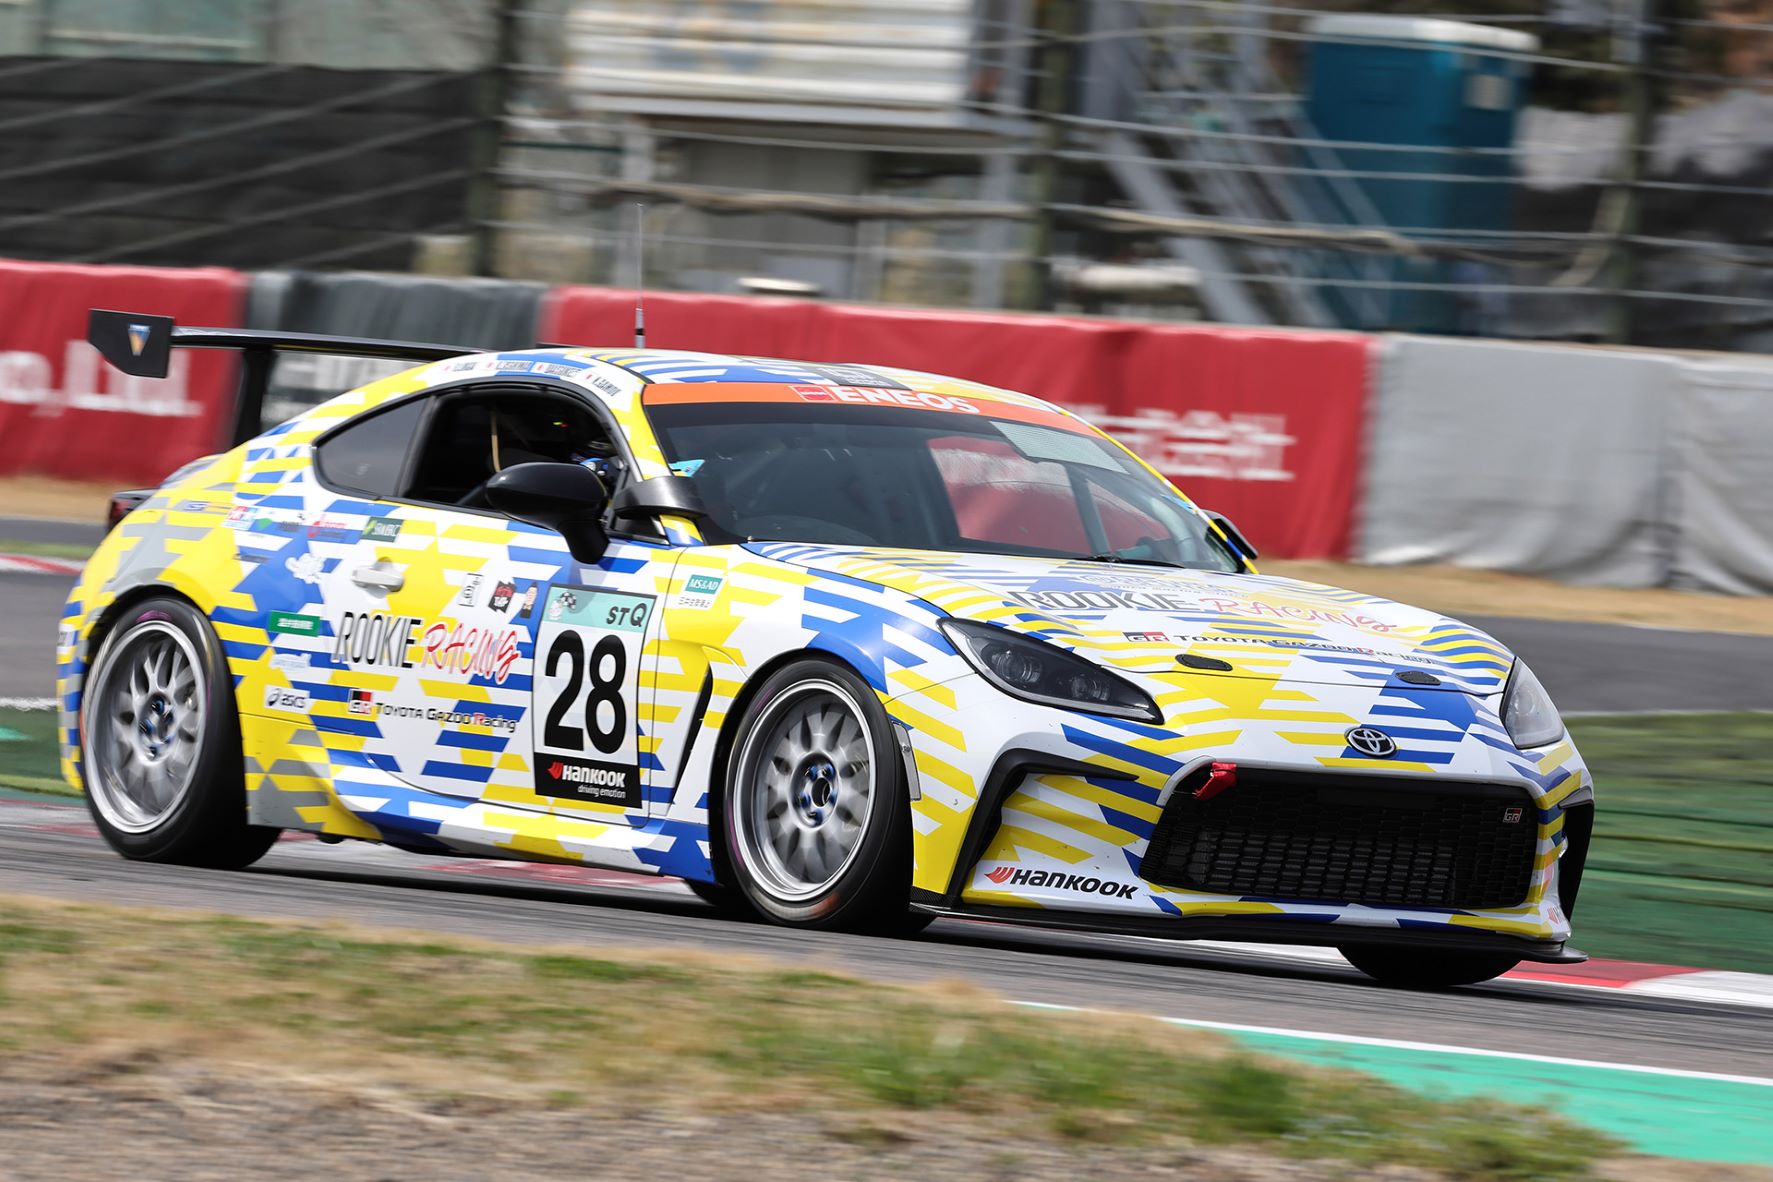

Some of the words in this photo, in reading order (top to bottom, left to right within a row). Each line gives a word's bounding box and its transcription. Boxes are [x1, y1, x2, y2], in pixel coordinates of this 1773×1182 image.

[827, 386, 981, 415] ENEOS
[688, 578, 719, 591] MS&AD
[1008, 591, 1200, 611] ROOKIE
[1199, 598, 1397, 633] RACING
[333, 612, 422, 669] ROOKIE
[422, 624, 519, 682] RACING
[1173, 635, 1267, 644] TOYOTA
[544, 630, 627, 754] 28
[376, 702, 424, 719] TOYOTA
[473, 712, 517, 733] Racing
[577, 784, 600, 798] driving
[600, 787, 626, 799] emotion
